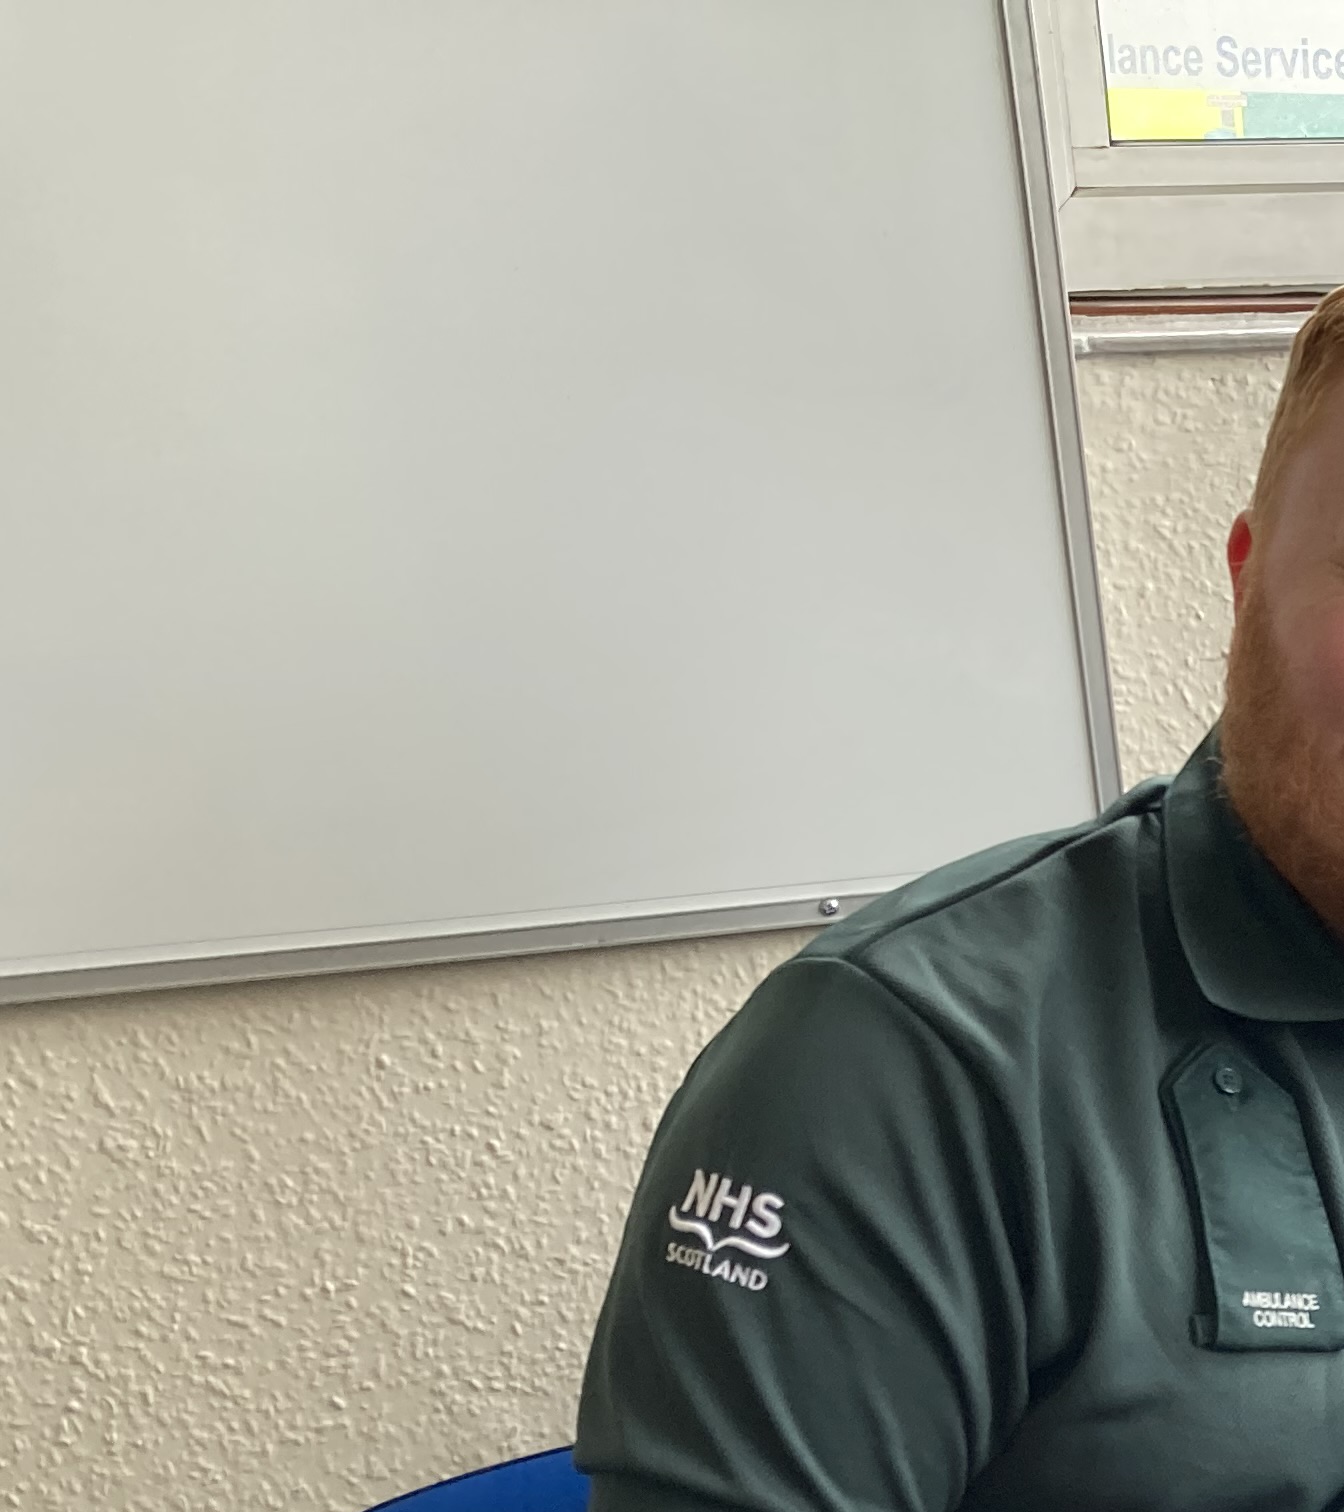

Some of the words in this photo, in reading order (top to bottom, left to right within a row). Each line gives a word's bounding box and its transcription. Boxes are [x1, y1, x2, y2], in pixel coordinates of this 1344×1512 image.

[680, 1168, 786, 1239] NHS
[665, 1241, 769, 1291] SCOTLAND
[1242, 1291, 1321, 1311] AMBULANCE
[1252, 1310, 1316, 1329] CONTROL
